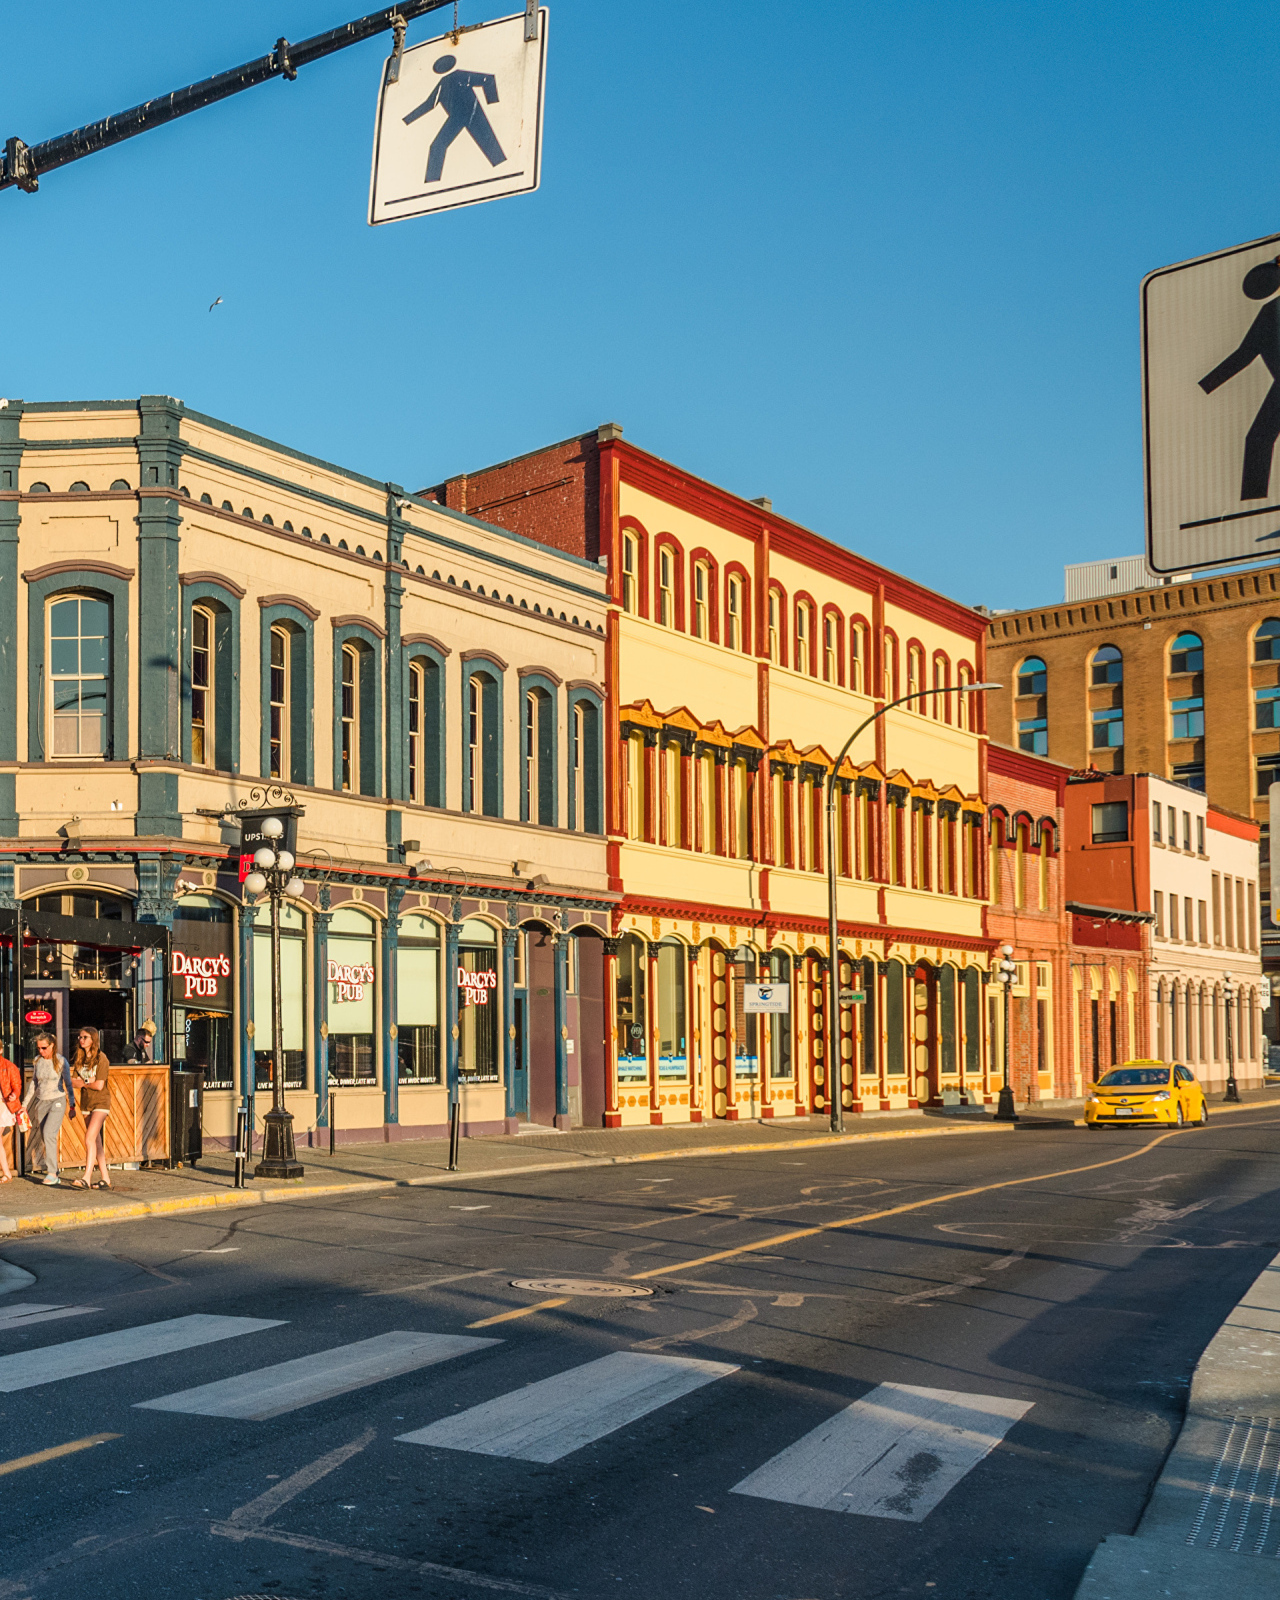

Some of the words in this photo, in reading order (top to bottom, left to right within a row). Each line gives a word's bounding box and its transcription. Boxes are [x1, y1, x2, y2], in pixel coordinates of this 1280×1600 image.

[172, 951, 230, 978] DARCY'S
[327, 960, 374, 985] DARCY'S
[184, 975, 218, 999] PUB
[457, 966, 497, 989] DARCY'S
[337, 981, 364, 1003] PUB
[464, 986, 488, 1007] PUB
[257, 1082, 268, 1090] LIVE
